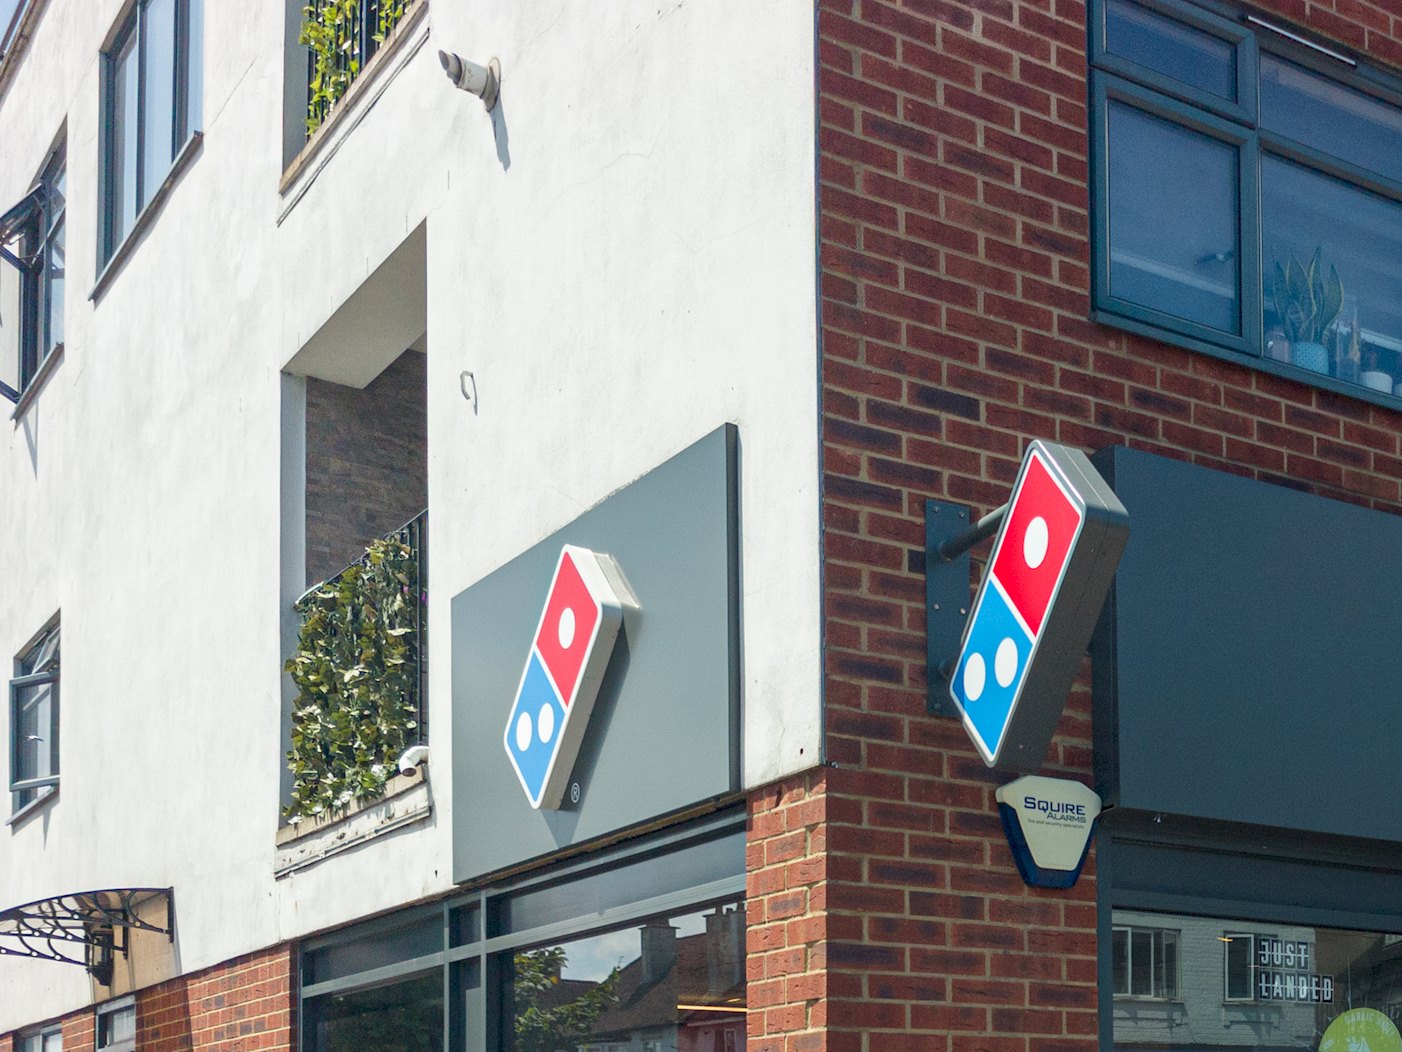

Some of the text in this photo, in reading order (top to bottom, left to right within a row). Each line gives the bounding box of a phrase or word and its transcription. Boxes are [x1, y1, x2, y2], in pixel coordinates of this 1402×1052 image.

[1024, 796, 1086, 816] SQUIRE
[1045, 820, 1062, 828] security
[1046, 811, 1087, 824] ALARMS
[1261, 940, 1309, 967] JUST
[1261, 973, 1333, 1001] LANDED
